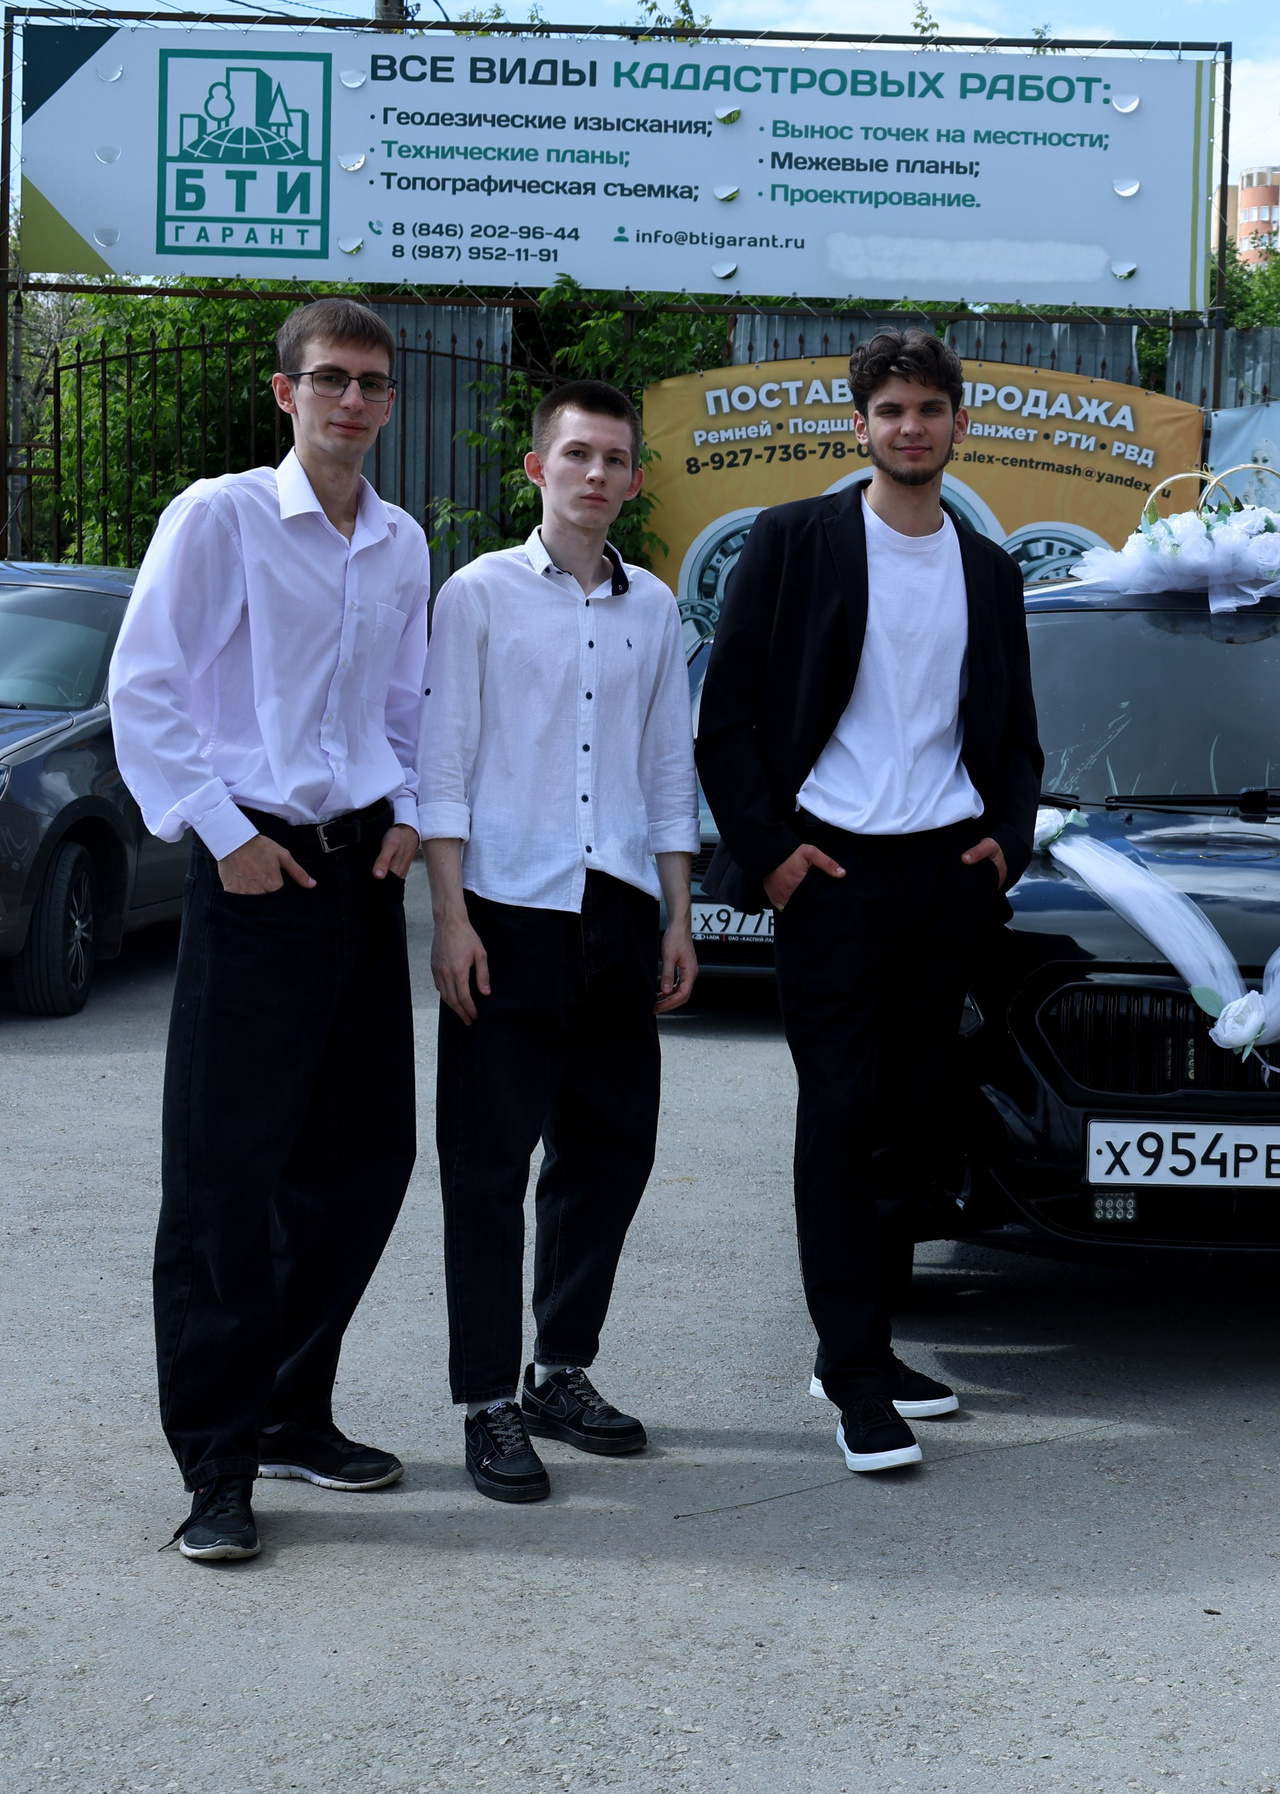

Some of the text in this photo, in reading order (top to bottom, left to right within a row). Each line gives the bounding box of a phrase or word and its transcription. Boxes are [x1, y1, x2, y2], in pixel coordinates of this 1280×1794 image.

[370, 54, 1112, 105] ВСЕ ВИДЫ КАДАСТРОВЫХ РАБОТ:
[382, 107, 713, 138] Геодезические изыскания;
[771, 119, 1110, 151] Вынос точек на местности;
[380, 139, 630, 168] Технические планы;
[770, 151, 980, 178] Межевые планы;
[175, 168, 311, 215] БТИ
[380, 171, 700, 203] Топографическая съемка;
[770, 183, 981, 209] Проектирование.
[174, 225, 310, 246] ГАРАНТ
[391, 222, 580, 242] 8 (846) 202-96-44
[635, 229, 805, 250] info@btigarant.ru
[391, 244, 558, 263] 8 (987) 952-11-91
[693, 420, 773, 447] Ремней
[966, 419, 1038, 443] анжет
[1053, 429, 1097, 452] РТИ
[1111, 440, 1155, 468] РВД
[963, 451, 1172, 499] alex-centrmash@yandex.u
